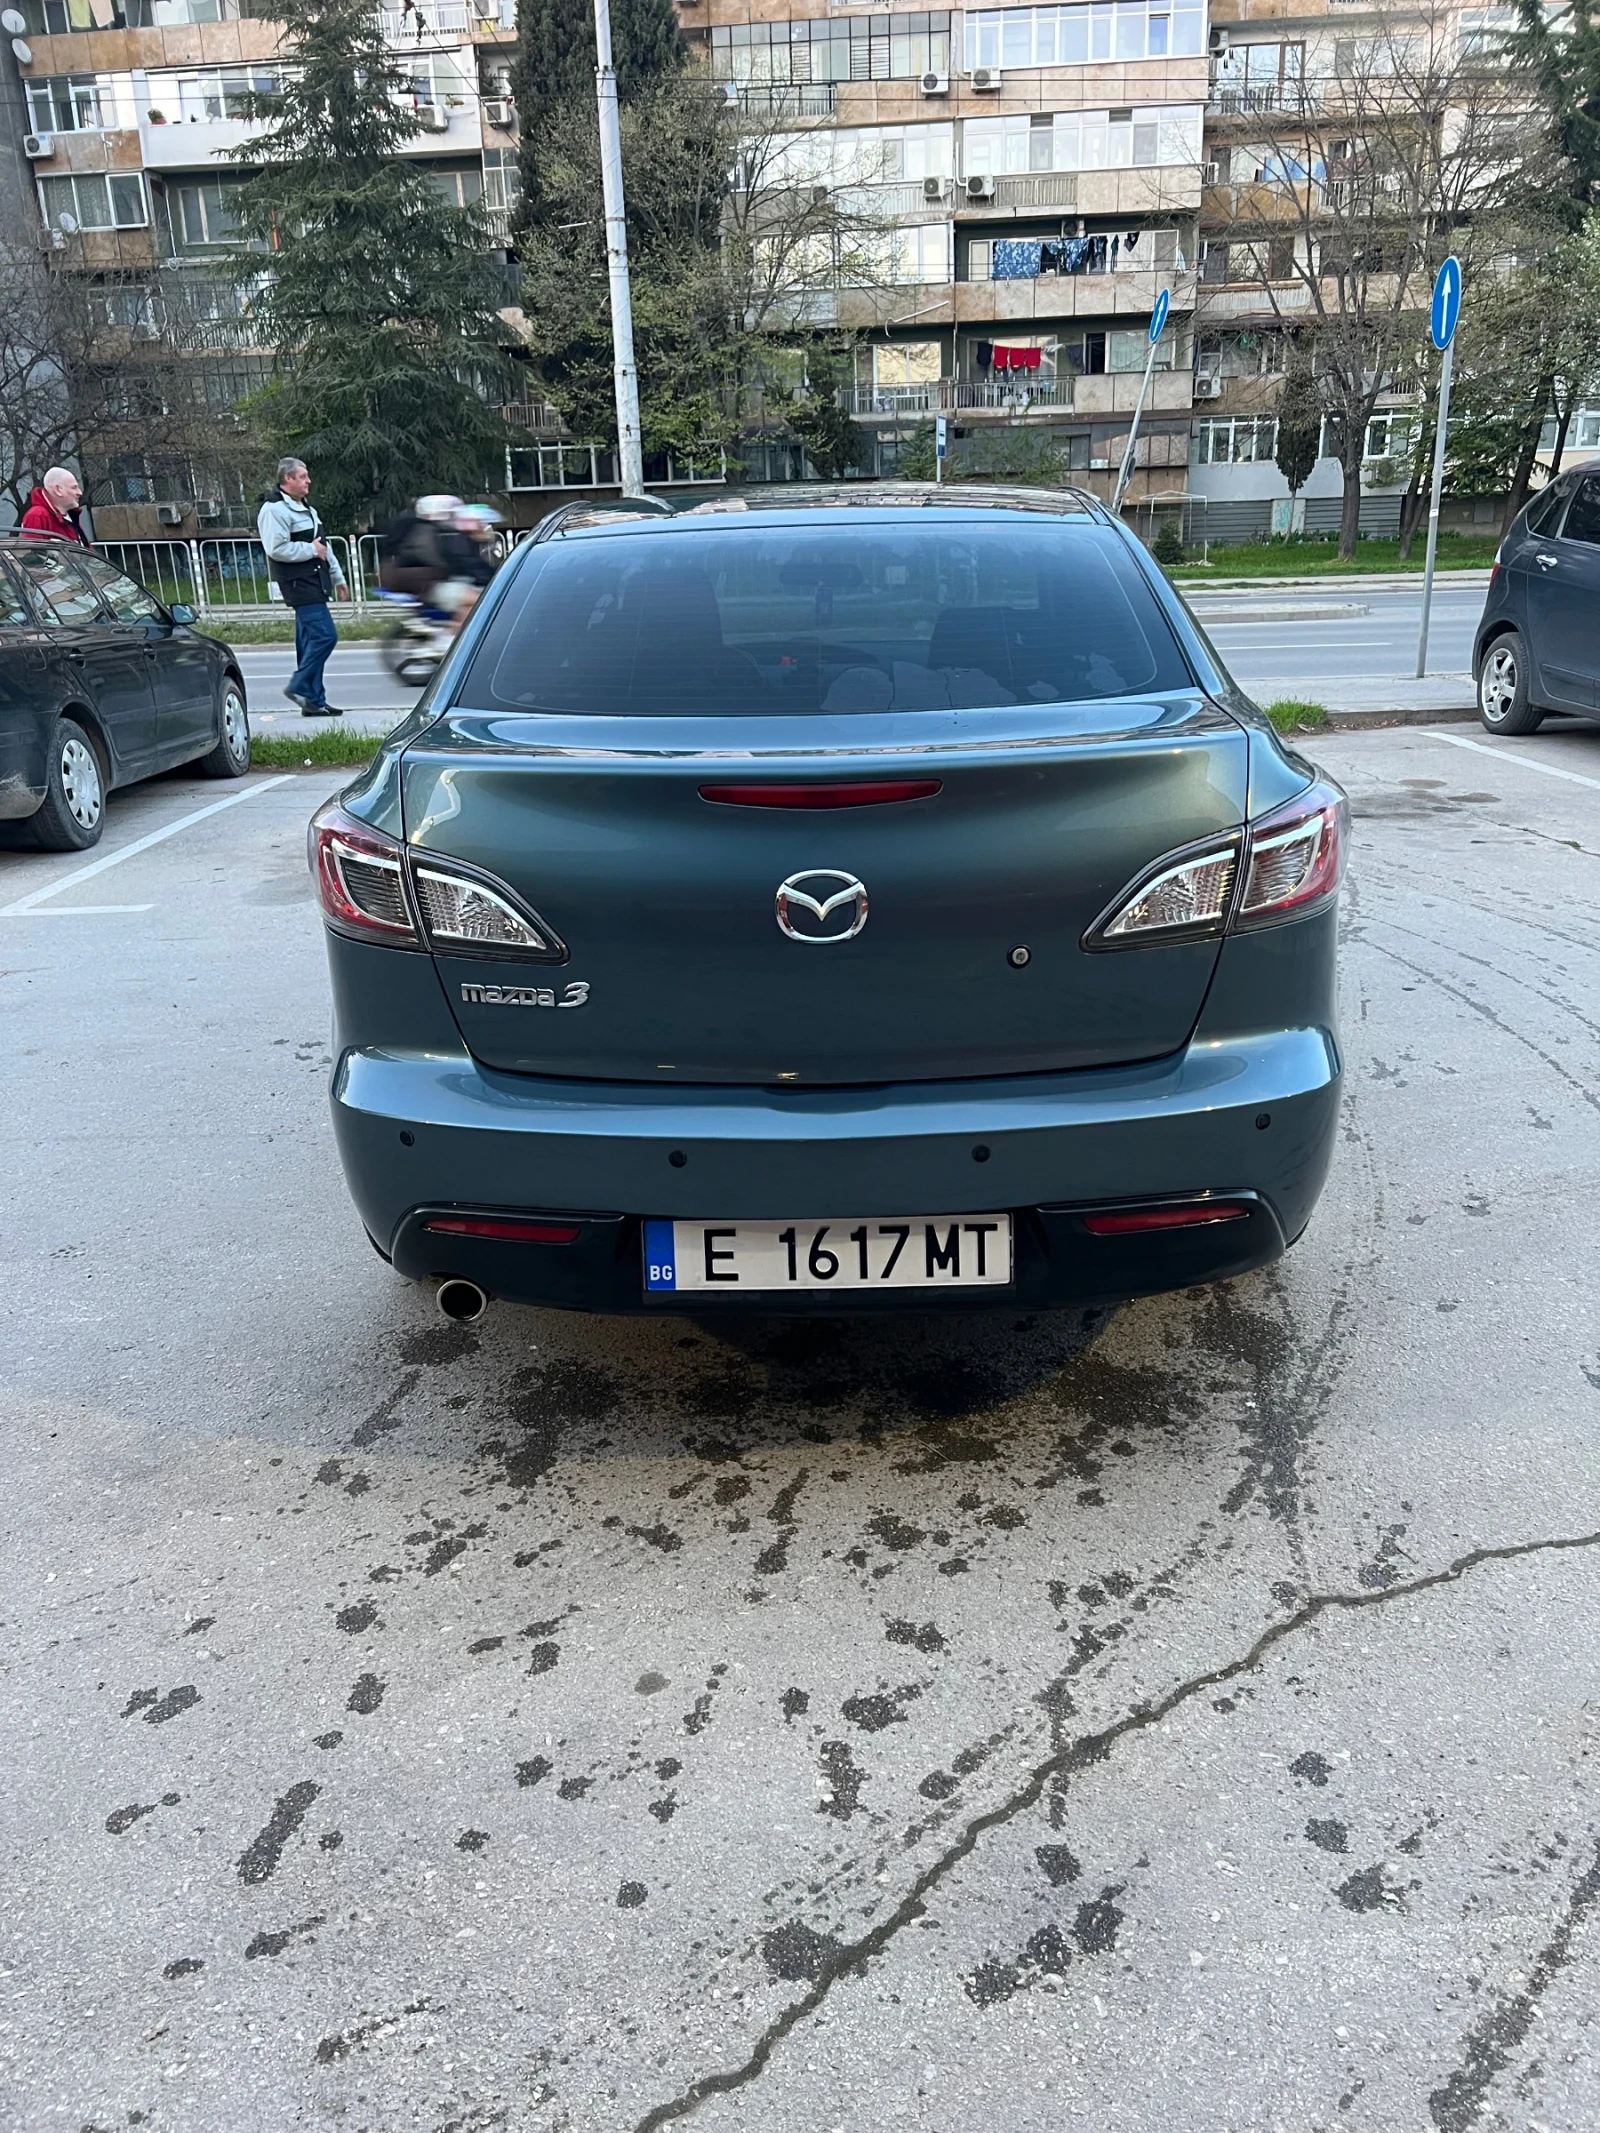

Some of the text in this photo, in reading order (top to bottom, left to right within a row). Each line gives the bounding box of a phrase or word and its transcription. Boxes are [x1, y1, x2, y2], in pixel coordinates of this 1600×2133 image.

[557, 981, 591, 1008] 3
[703, 1222, 999, 1282] E 1617 MT
[649, 1265, 673, 1281] BG
